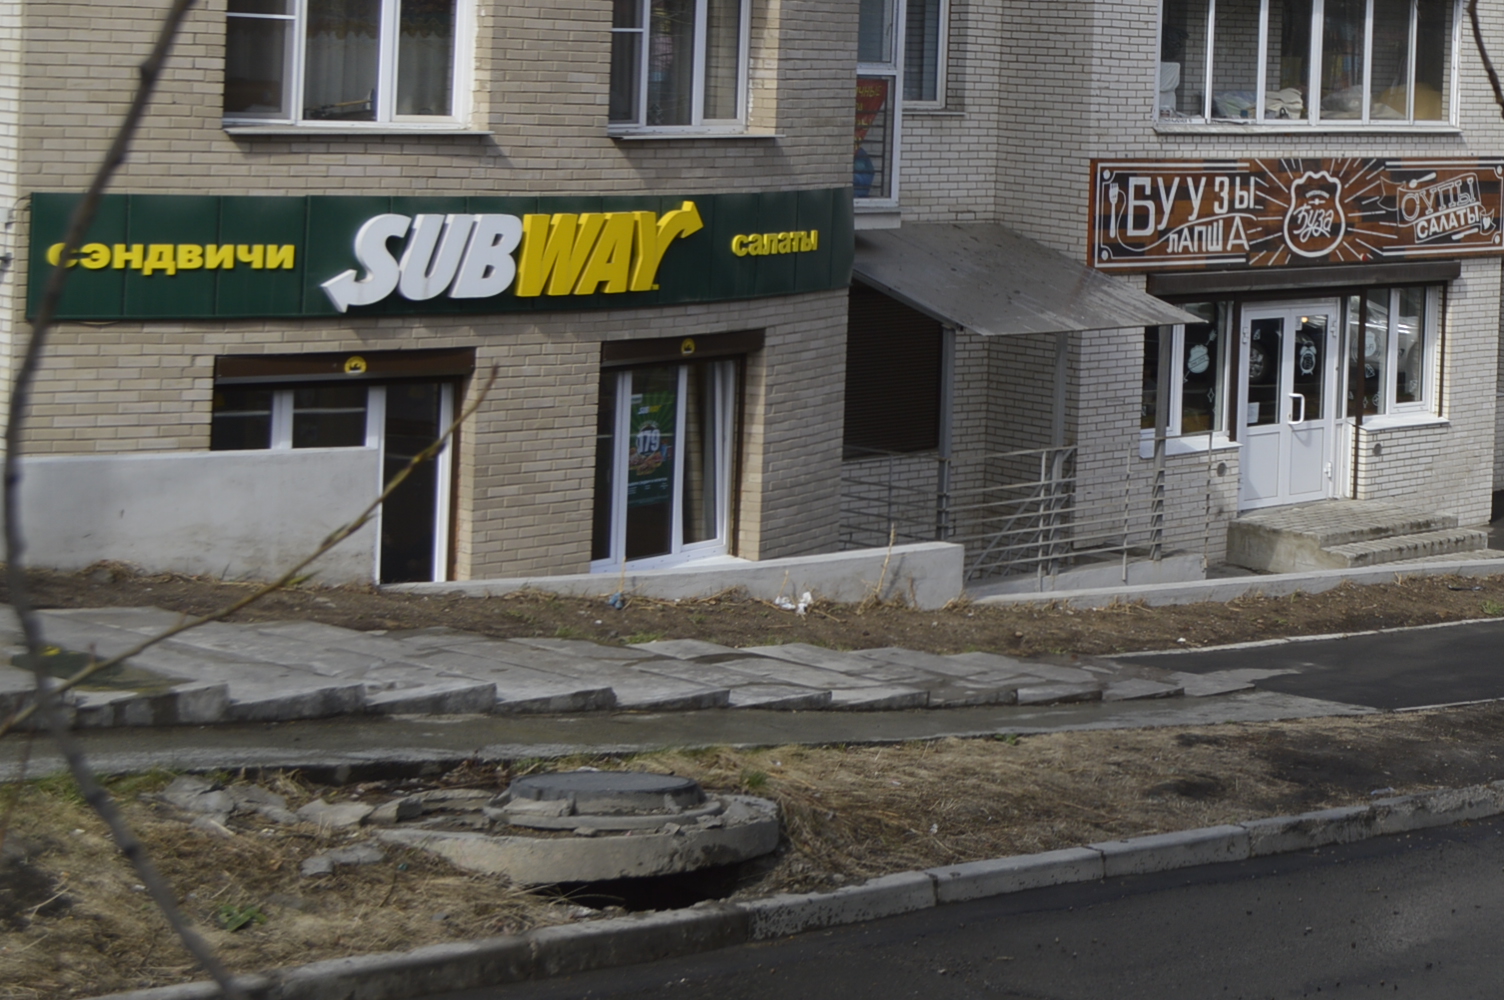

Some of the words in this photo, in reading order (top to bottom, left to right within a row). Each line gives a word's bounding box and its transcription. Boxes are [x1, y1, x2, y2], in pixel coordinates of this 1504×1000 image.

[1127, 176, 1255, 236] БУУЗЫ
[1401, 177, 1476, 221] СУПЫ
[1416, 205, 1479, 238] САЛАТЫ
[46, 242, 295, 276] сэндвичи
[321, 201, 704, 313] SUBWAY
[731, 230, 819, 257] салаты
